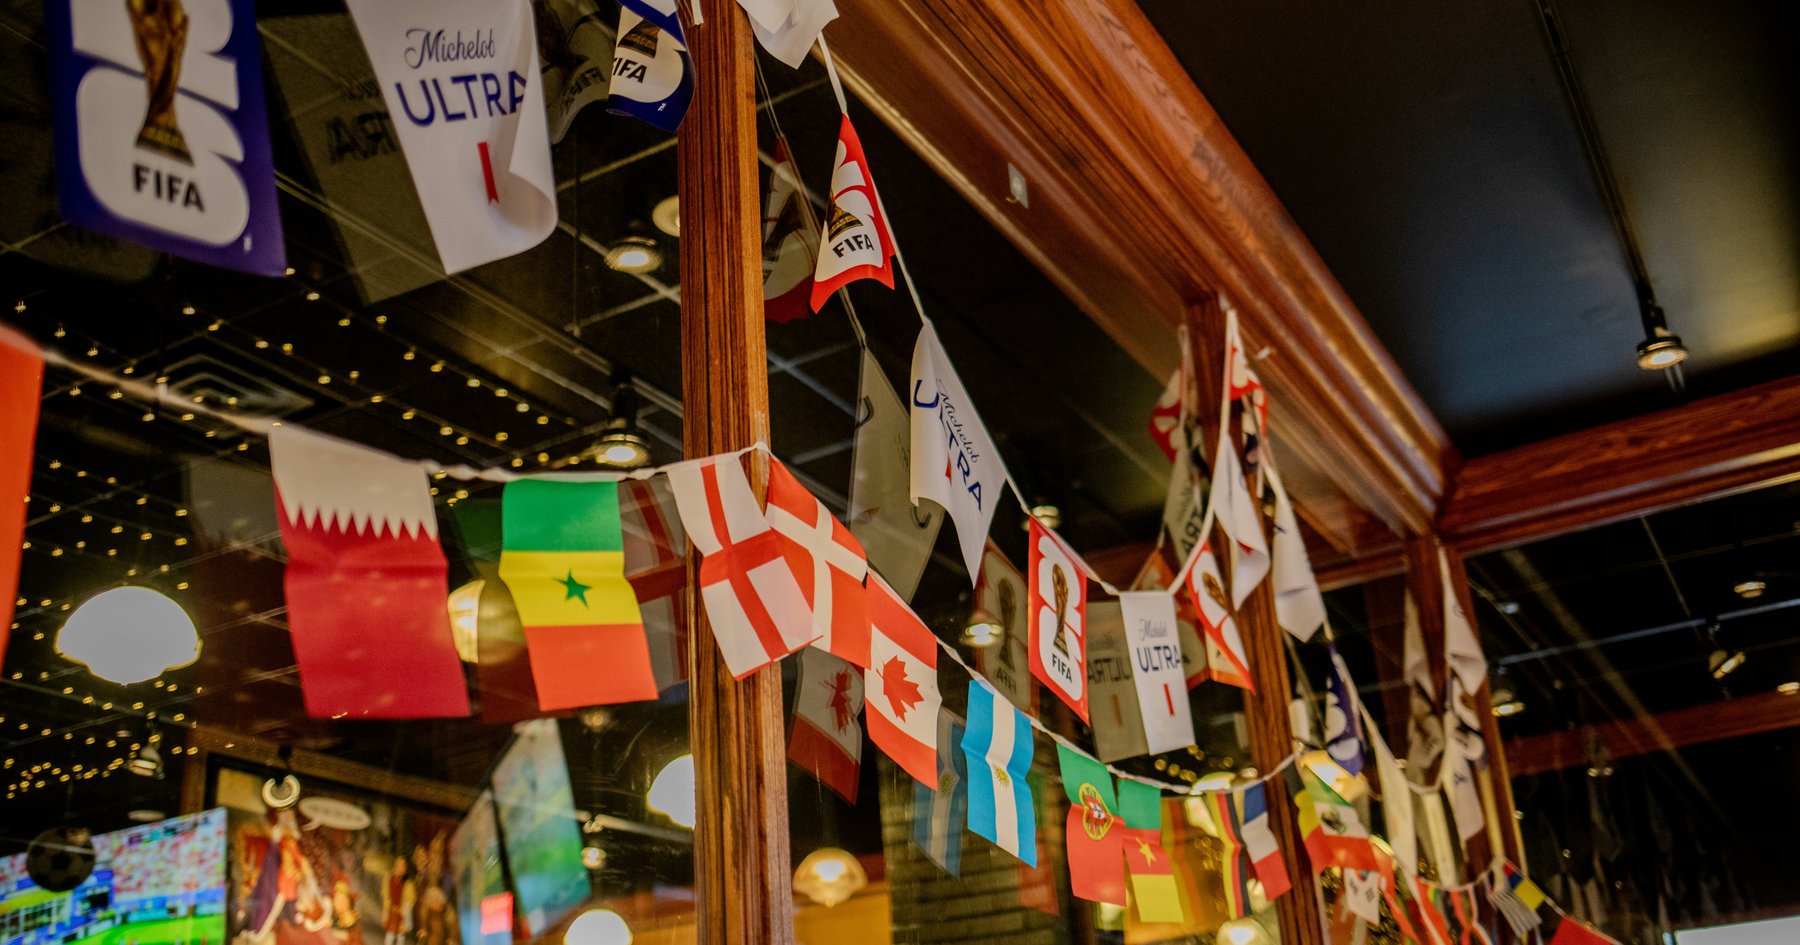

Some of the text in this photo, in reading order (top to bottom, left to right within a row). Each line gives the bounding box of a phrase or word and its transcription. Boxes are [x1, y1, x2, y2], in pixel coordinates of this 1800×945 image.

[404, 28, 496, 69] Michelob
[612, 57, 647, 84] IFA
[394, 70, 527, 127] ULTRA
[132, 162, 206, 213] FIFA
[832, 233, 875, 258] FIFA
[935, 377, 980, 463] Michelob
[1051, 653, 1073, 684] FIFA
